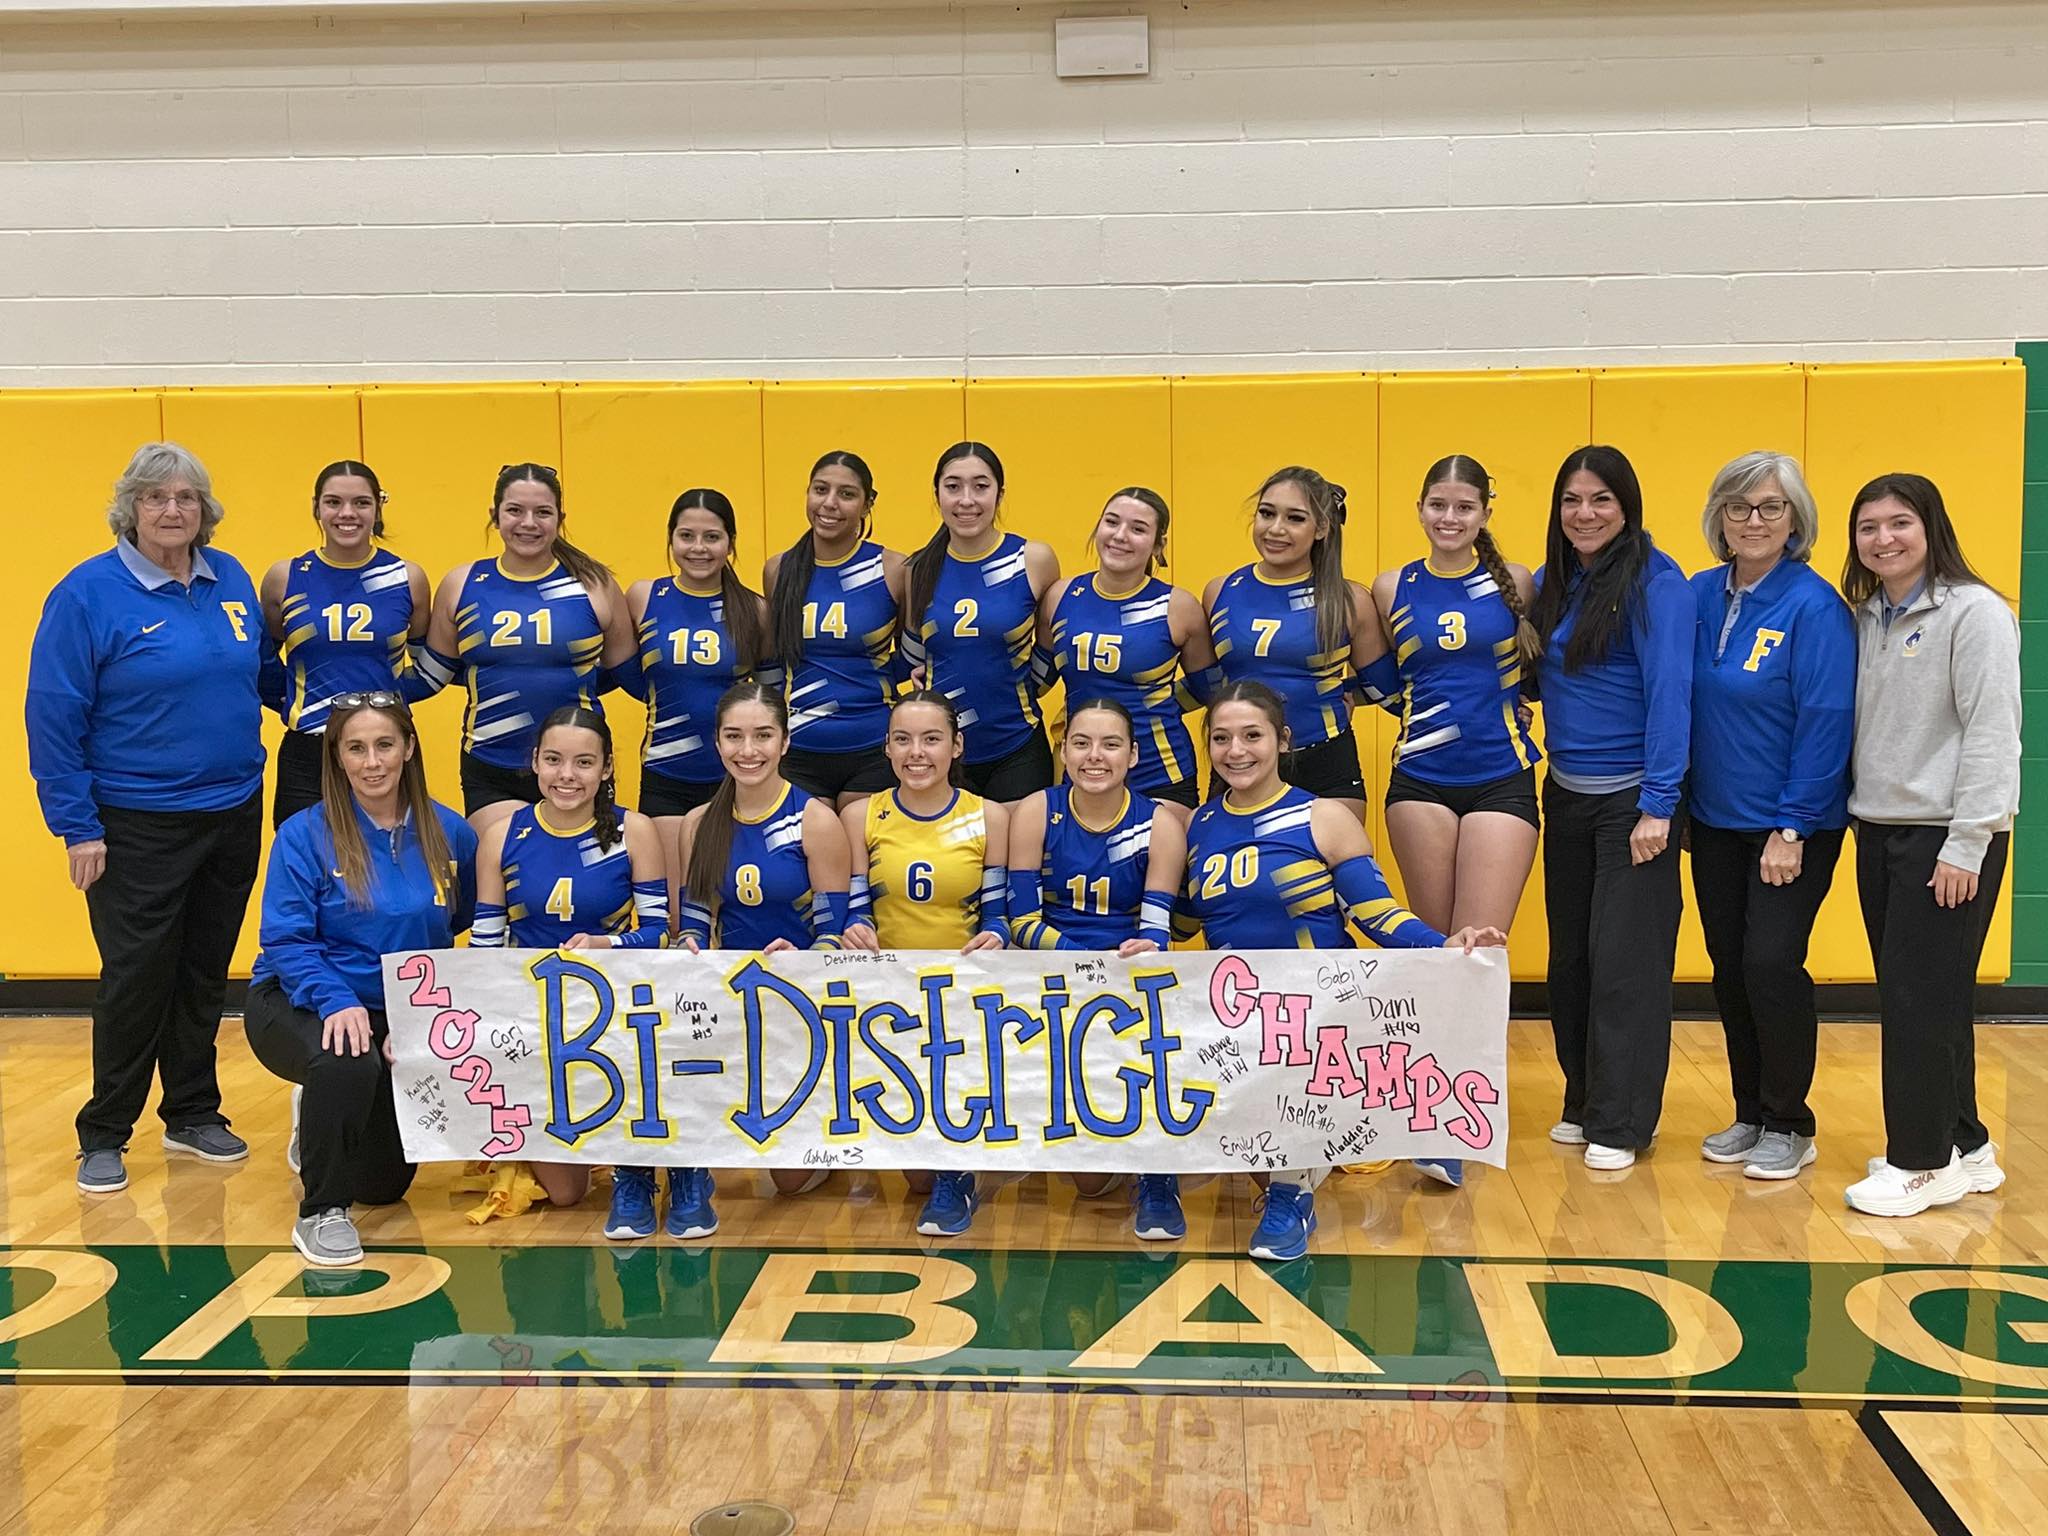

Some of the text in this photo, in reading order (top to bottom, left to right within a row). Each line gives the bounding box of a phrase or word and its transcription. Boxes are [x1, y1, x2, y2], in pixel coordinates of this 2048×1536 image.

[220, 601, 248, 641] F
[321, 602, 375, 641] 12
[490, 607, 552, 647] 21
[801, 602, 848, 640] 14
[953, 598, 979, 638] 2
[1437, 610, 1468, 651] 3
[667, 628, 721, 666] 13
[1071, 631, 1123, 673] 15
[1250, 618, 1282, 657] 7
[1743, 627, 1785, 673] F
[735, 863, 764, 906] 8
[905, 860, 935, 904] 6
[1201, 845, 1260, 901] 20
[545, 876, 575, 922] 4
[1066, 874, 1111, 916] 11
[823, 953, 898, 967] Destinee #21
[1317, 960, 1355, 991] Gabi
[675, 992, 709, 1015] Kara
[1335, 984, 1364, 1003] #11
[1362, 990, 1417, 1021] Dani
[490, 1021, 523, 1048] Cori
[1380, 1021, 1406, 1036] #4
[397, 954, 532, 1158] 2025
[504, 1039, 533, 1063] #2
[1209, 954, 1500, 1150] CHAMPS
[1217, 1057, 1248, 1084] #14
[1315, 1116, 1336, 1133] #6
[1219, 1136, 1254, 1157] Emily
[1264, 1153, 1288, 1169] #8
[1902, 1171, 1936, 1194] HOKA
